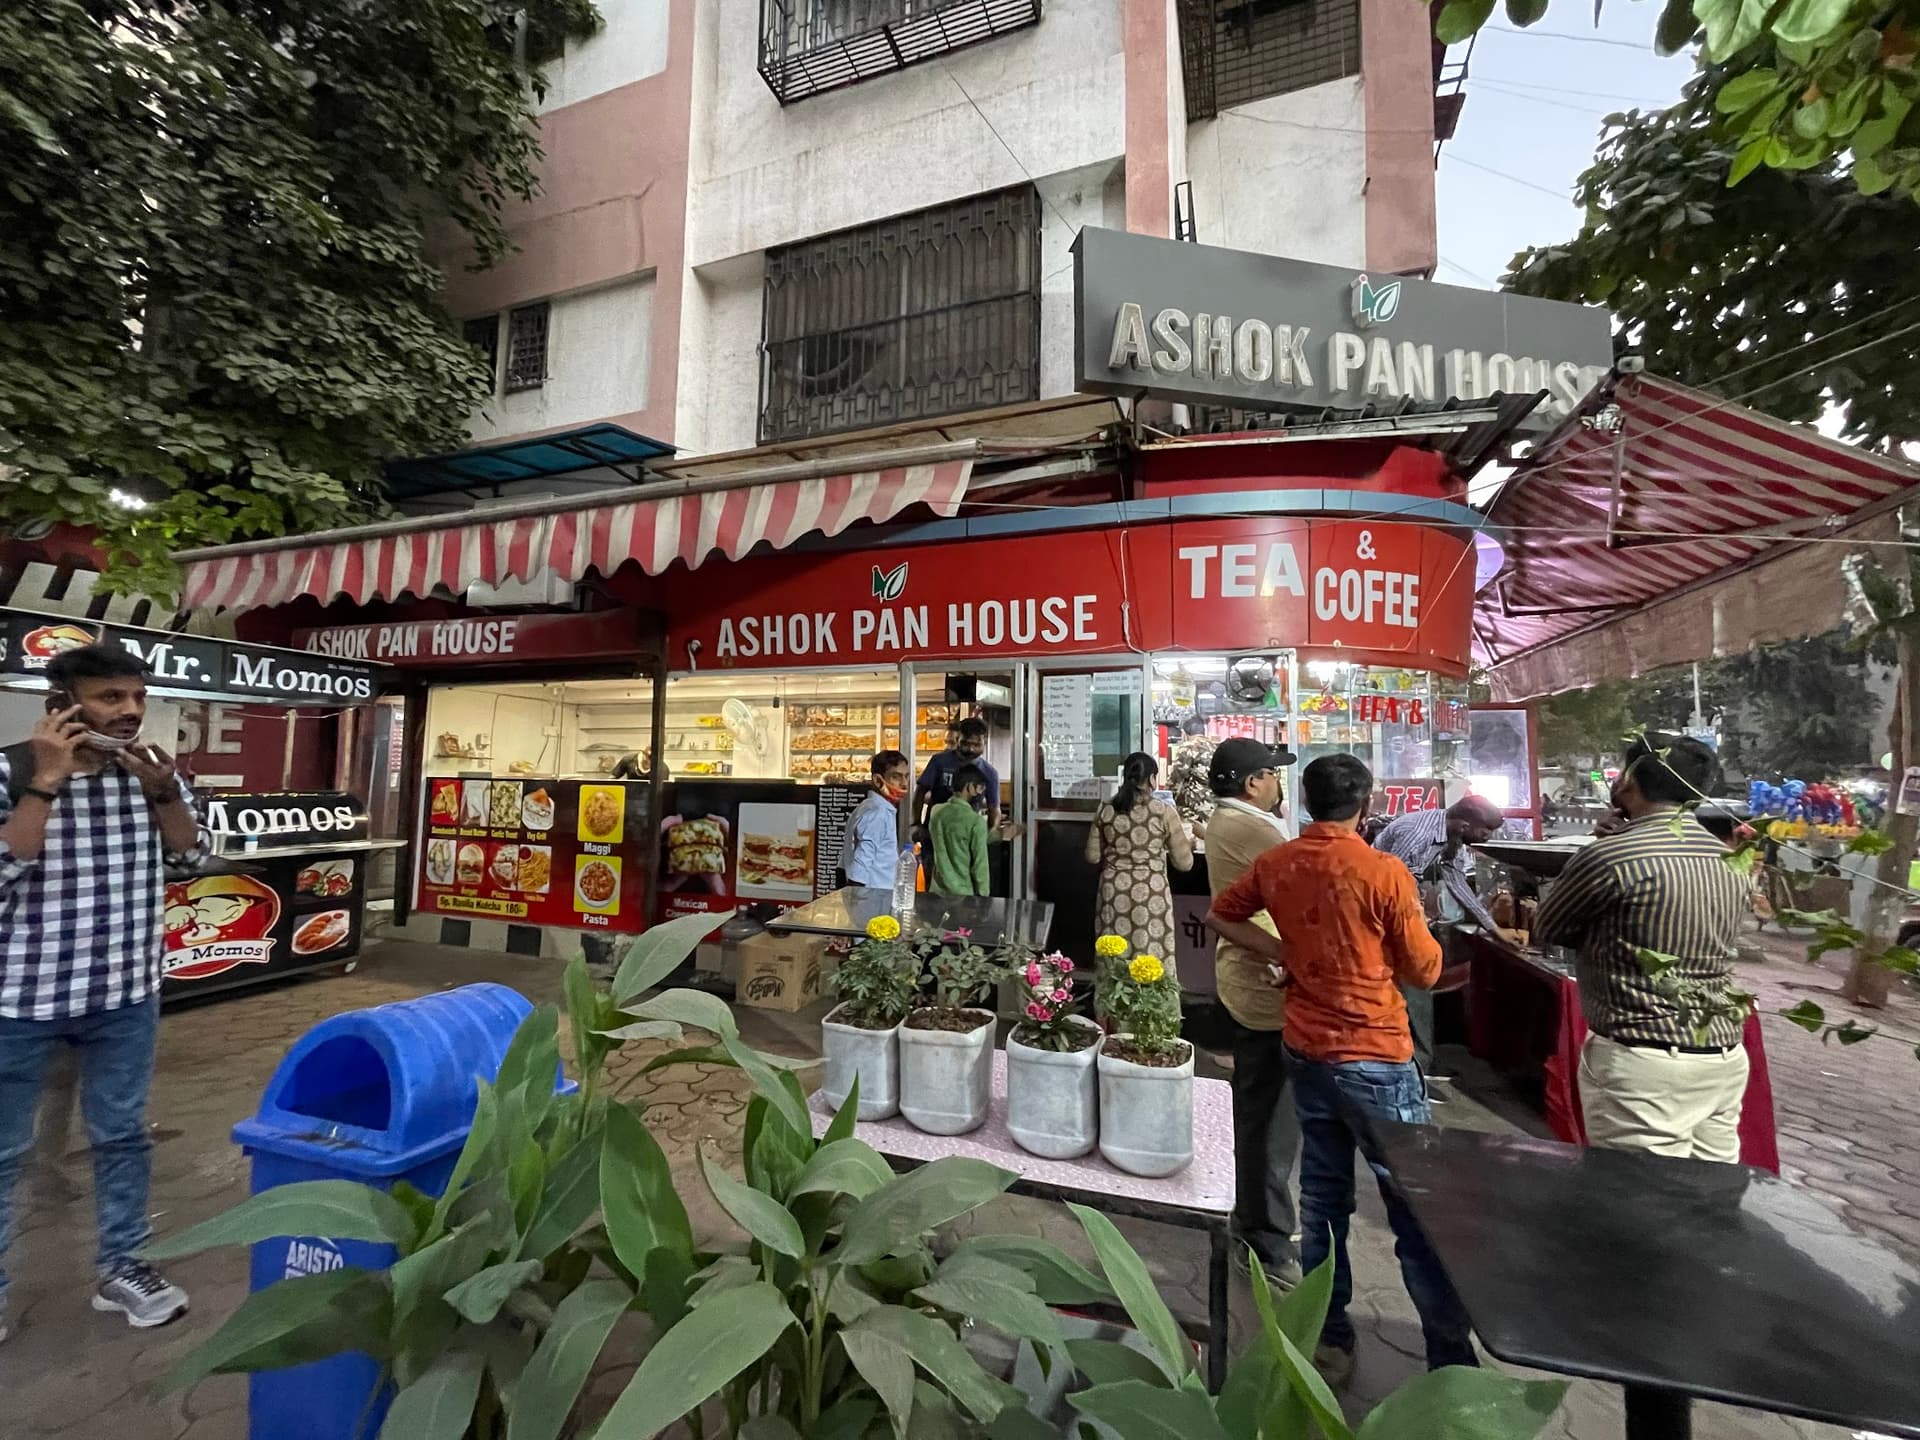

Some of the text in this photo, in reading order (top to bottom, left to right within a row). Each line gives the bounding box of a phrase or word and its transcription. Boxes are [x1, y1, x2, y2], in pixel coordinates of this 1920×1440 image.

[1109, 302, 1314, 388] ASHOK
[1328, 332, 1435, 401] PAN
[1357, 530, 1376, 560] &
[1179, 543, 1305, 599] TEA
[1315, 567, 1419, 628] COFEE
[306, 621, 518, 658] ASHOK PAN HOUSE
[716, 595, 1098, 657] ASHOK PAN HOUSE
[120, 638, 371, 698] Mr. Momos
[1358, 695, 1401, 724] TEA
[1385, 786, 1439, 817] TEA
[583, 842, 612, 856] Maggi
[582, 913, 609, 926] Pasta
[673, 897, 709, 910] Mexican
[191, 944, 264, 960] Momos
[286, 1240, 344, 1274] ARISTO
